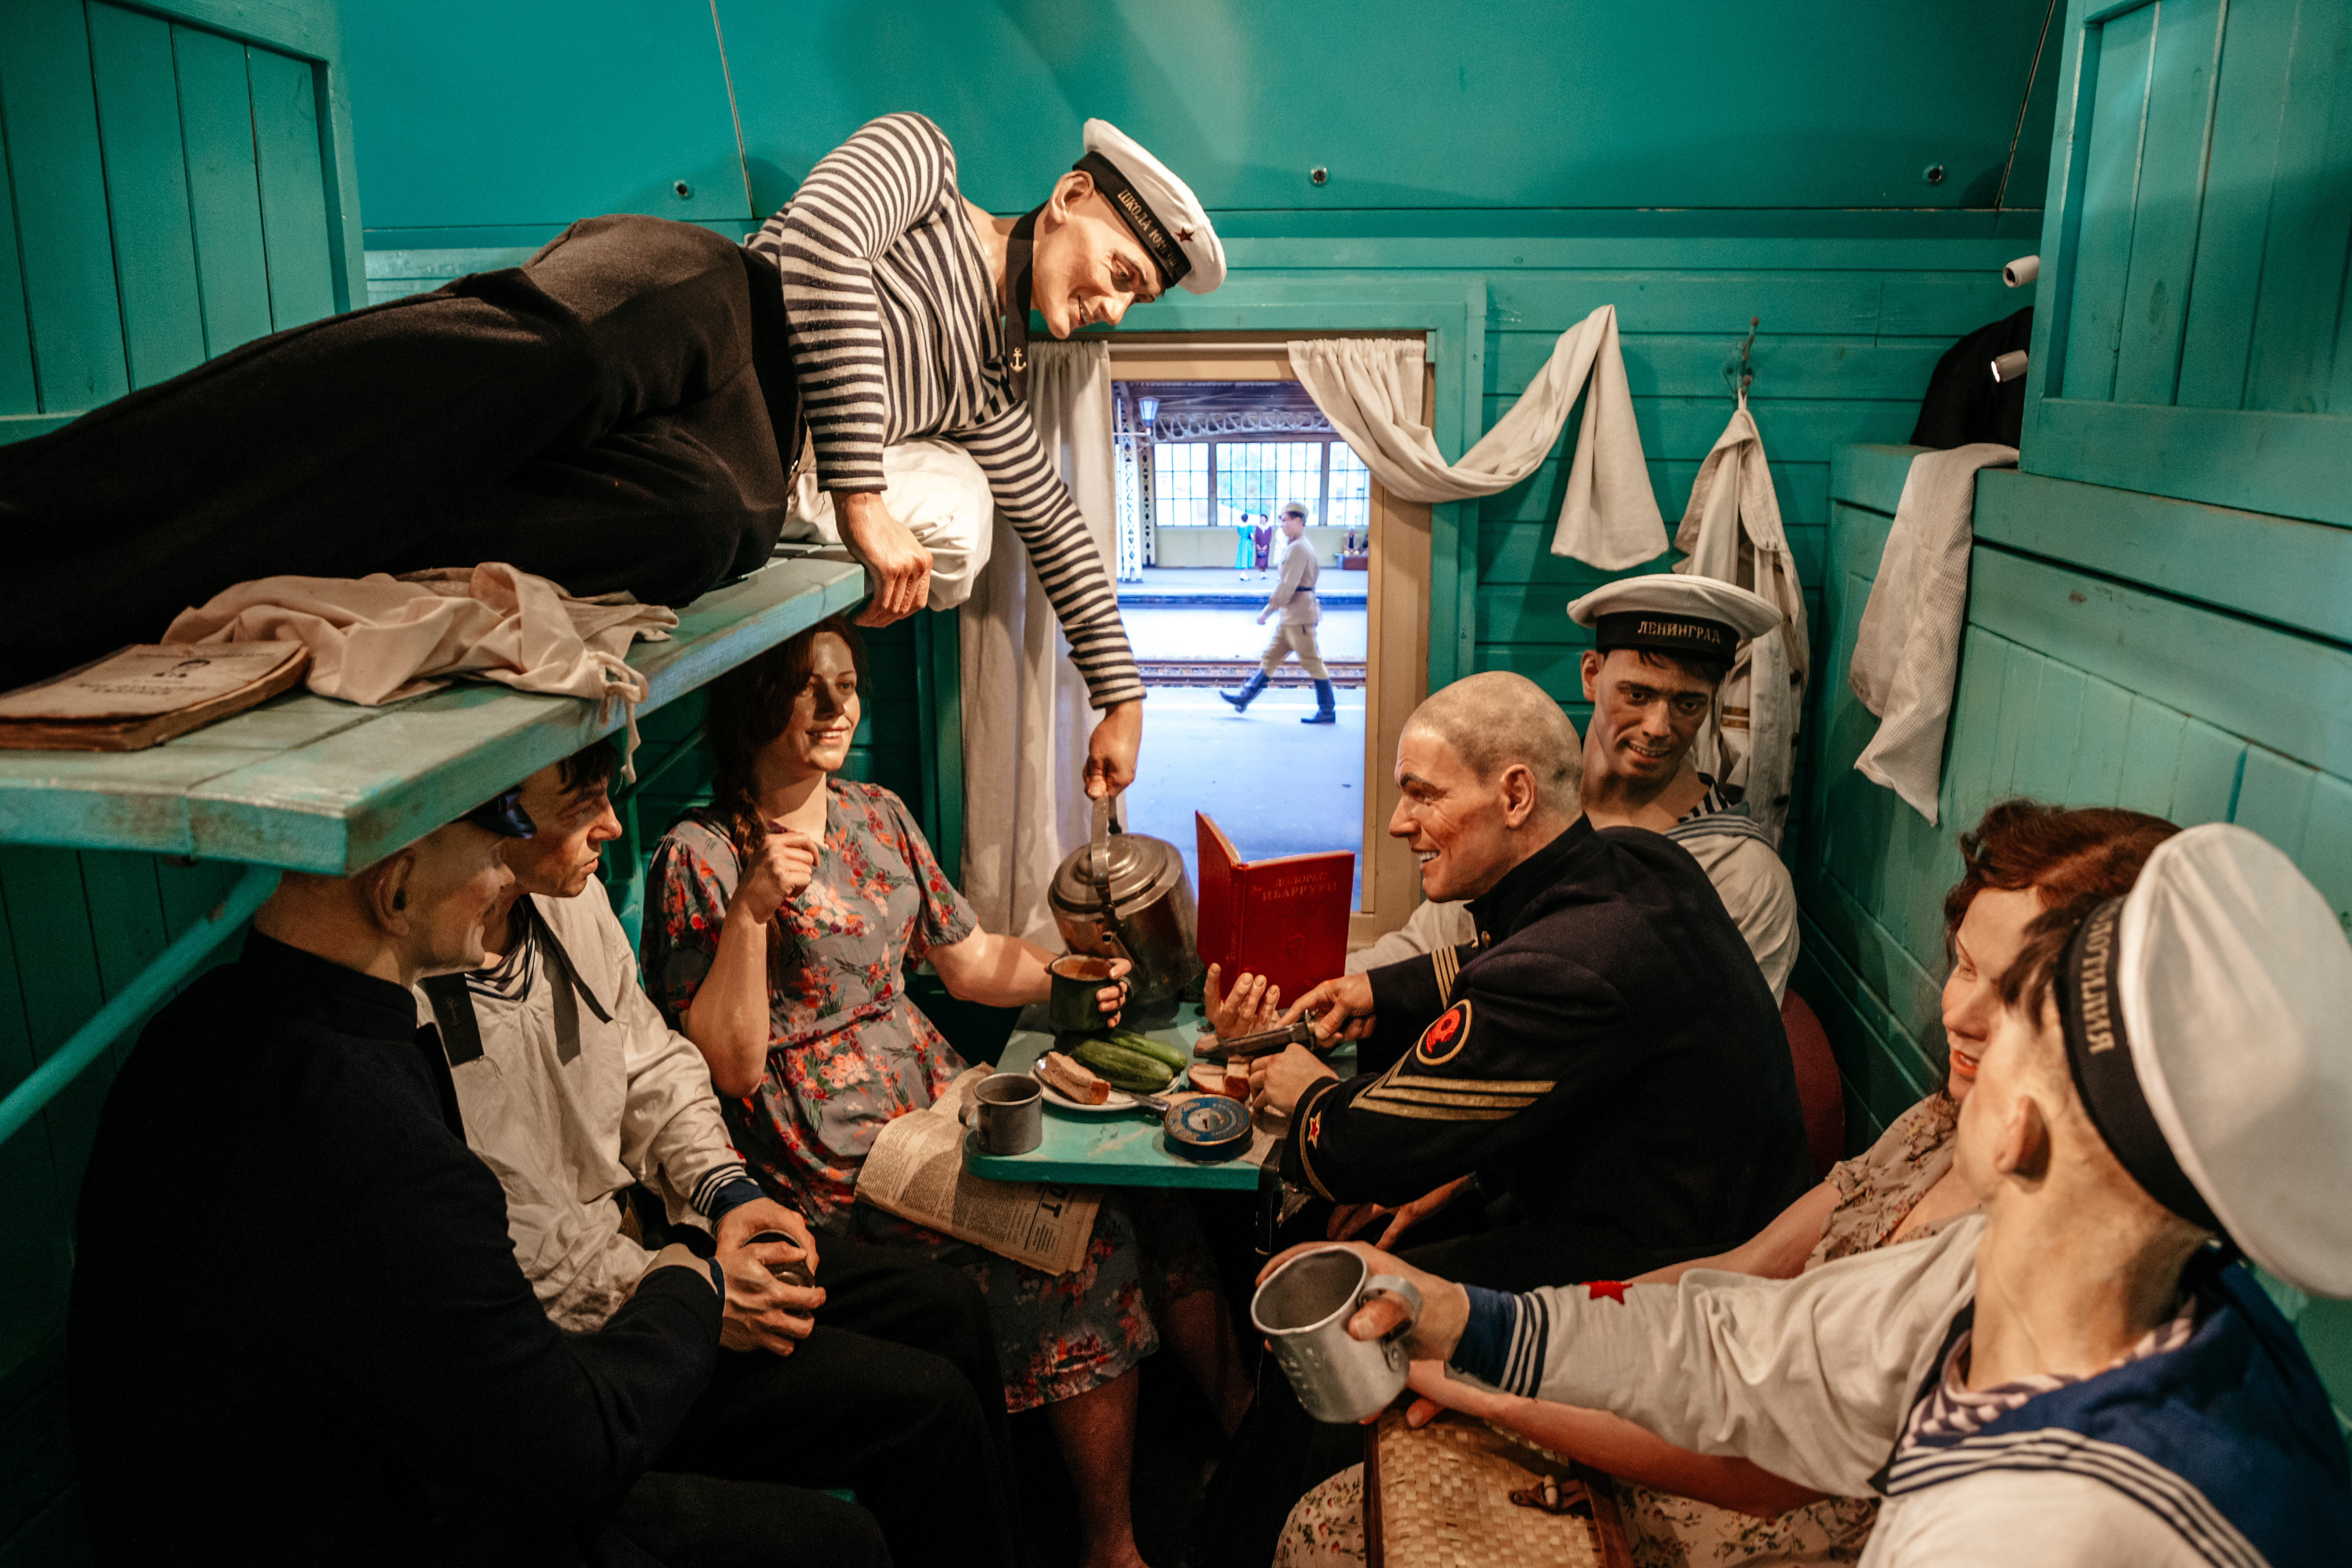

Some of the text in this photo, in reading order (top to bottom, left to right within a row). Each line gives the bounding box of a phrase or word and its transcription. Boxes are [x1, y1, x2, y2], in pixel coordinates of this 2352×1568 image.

[1117, 189, 1153, 231] ШКОЛА
[1638, 621, 1720, 644] ЛЕНИНГРАД
[1263, 882, 1336, 900] ИБАРРУРИ
[1275, 872, 1327, 887] ДОЛОРЕС
[1041, 1185, 1069, 1217] ОТ
